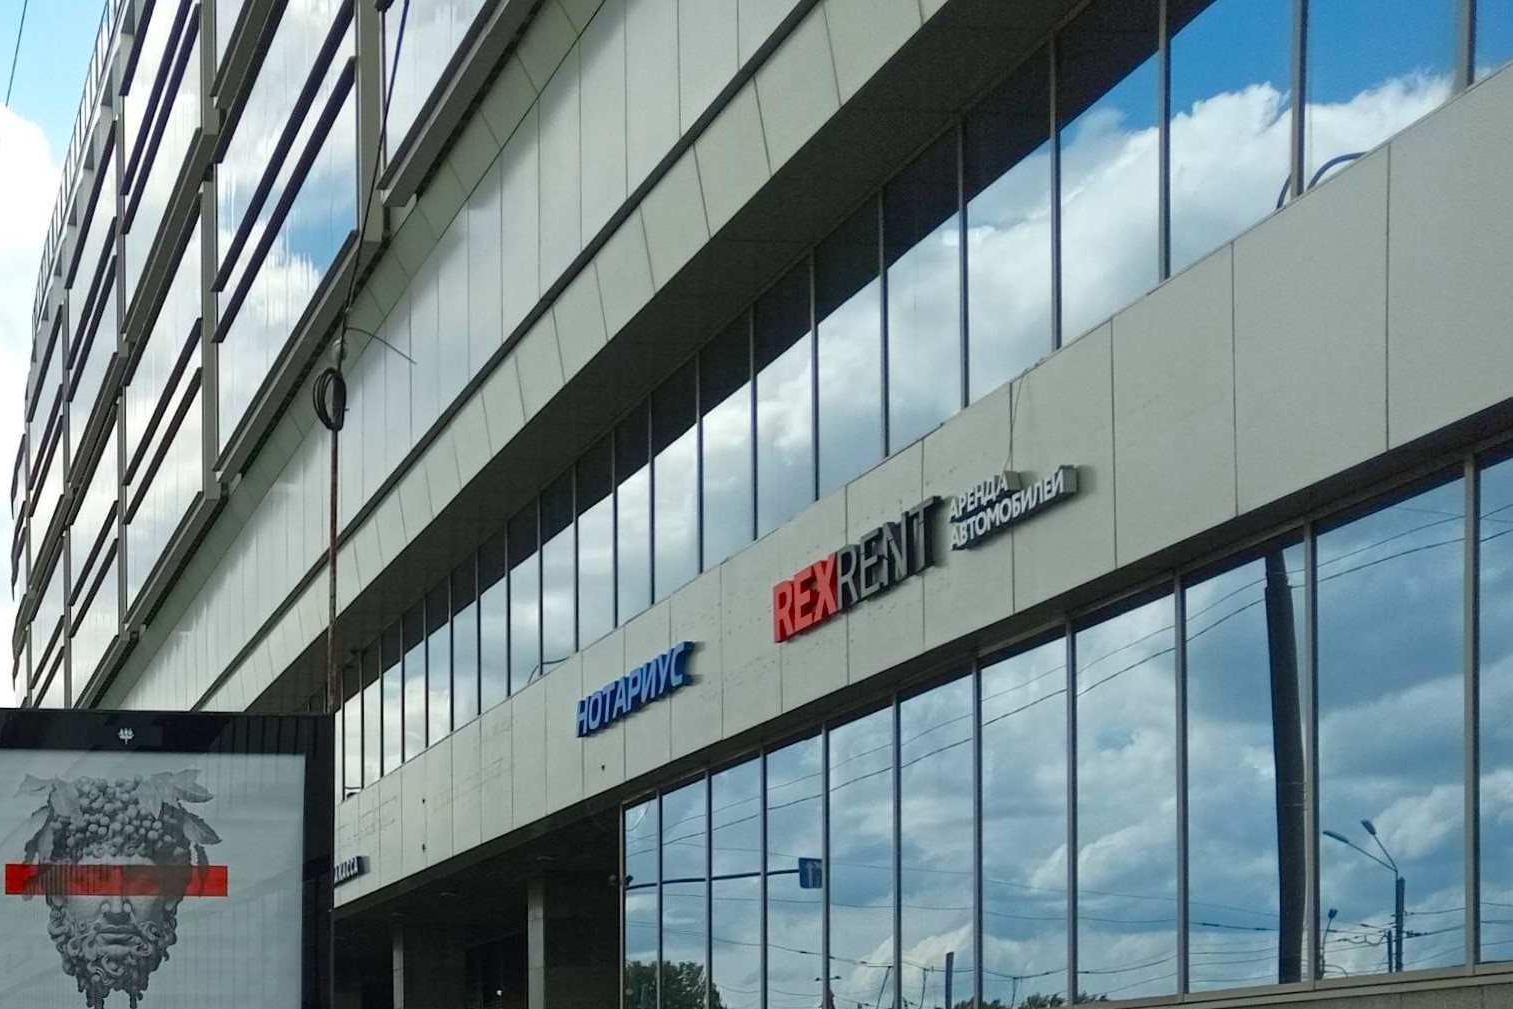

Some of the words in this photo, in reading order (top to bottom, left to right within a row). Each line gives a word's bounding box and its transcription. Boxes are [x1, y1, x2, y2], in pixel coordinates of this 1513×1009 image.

[948, 470, 1013, 521] АРЕНДА
[950, 465, 1069, 549] АВТОМОБИЛЕЙ
[576, 641, 693, 738] НОТАРИУС
